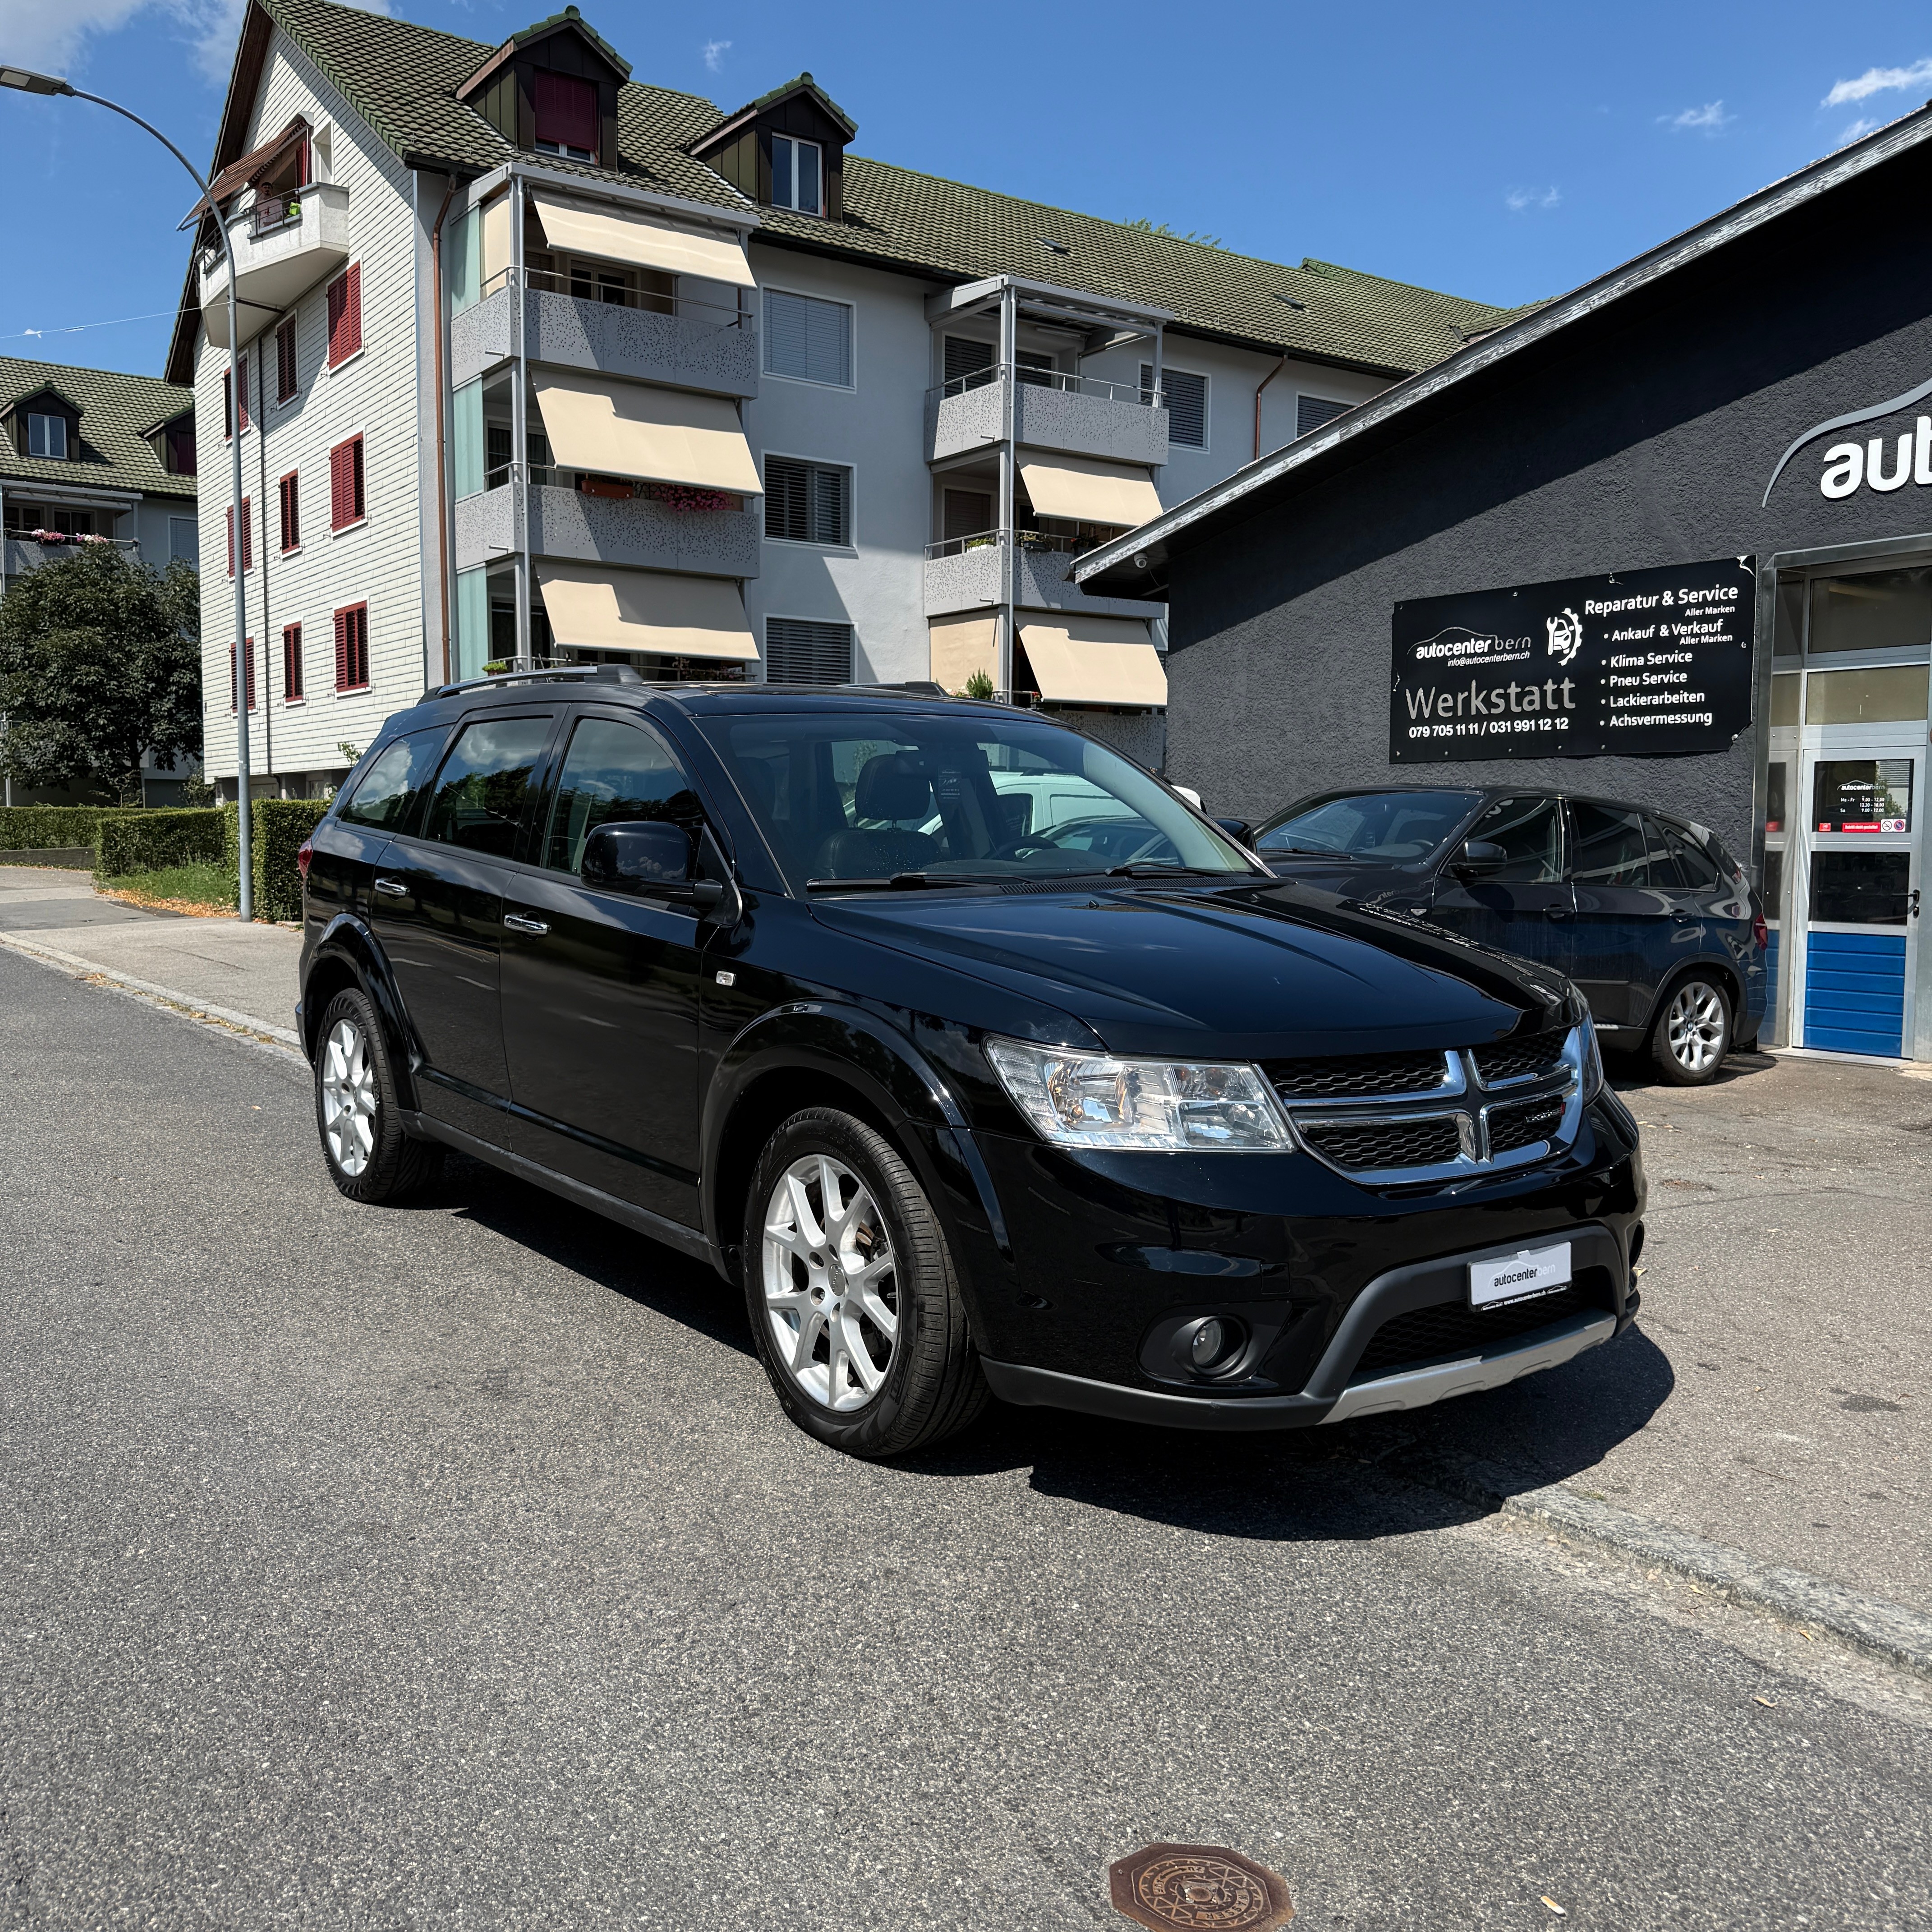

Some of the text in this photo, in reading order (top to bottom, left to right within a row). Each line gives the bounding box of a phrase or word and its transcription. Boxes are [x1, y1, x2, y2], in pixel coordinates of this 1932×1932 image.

[1585, 584, 1738, 617] Reparatur & Service
[1685, 605, 1735, 616] Aller Marken
[1611, 619, 1723, 641] Ankauf & Verkauf
[1679, 635, 1733, 645] Aller Marken
[1447, 651, 1530, 667] info@autocenterbern.ch
[1610, 650, 1693, 668] Klima Service
[1610, 670, 1687, 687] Pneu Service
[1406, 677, 1576, 719] Werkstatt
[1610, 690, 1705, 707] Lackierarbeiten
[1409, 718, 1569, 738] 079 705 11 11 / 031 991 12 12
[1609, 712, 1712, 727] Achsvermessung
[1205, 1895, 1248, 1919] WASSER
